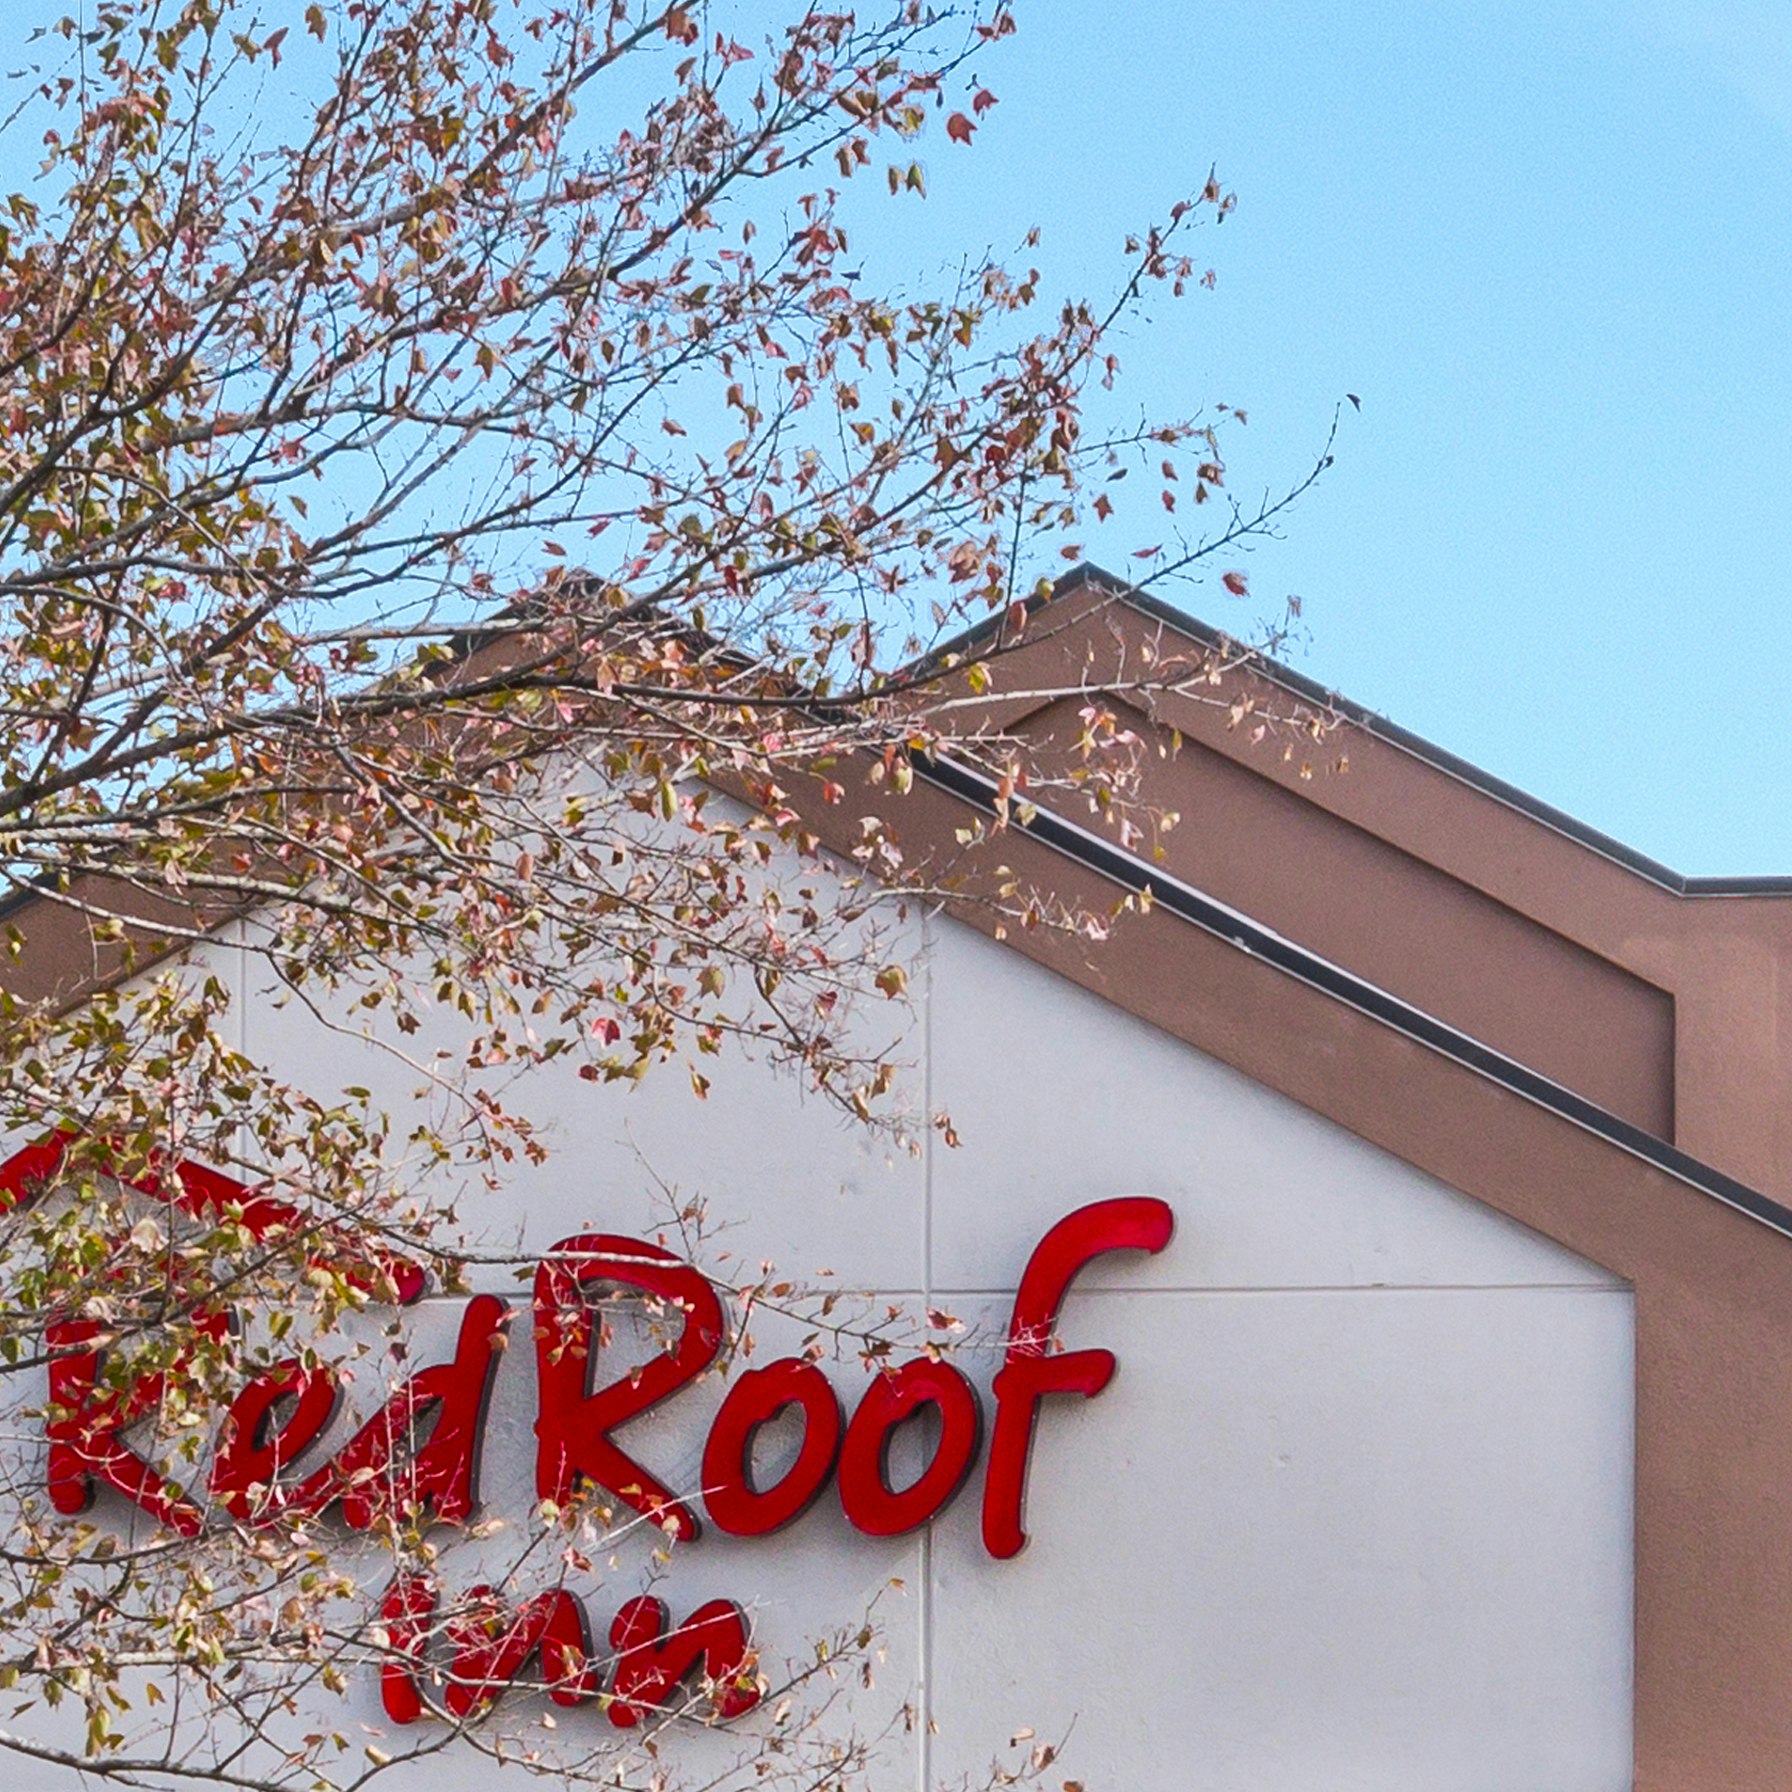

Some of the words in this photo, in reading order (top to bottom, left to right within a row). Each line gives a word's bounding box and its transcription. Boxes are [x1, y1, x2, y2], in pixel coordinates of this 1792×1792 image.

[46, 1243, 510, 1537] Red
[533, 1196, 1176, 1562] Roof
[380, 1574, 764, 1729] Inn
